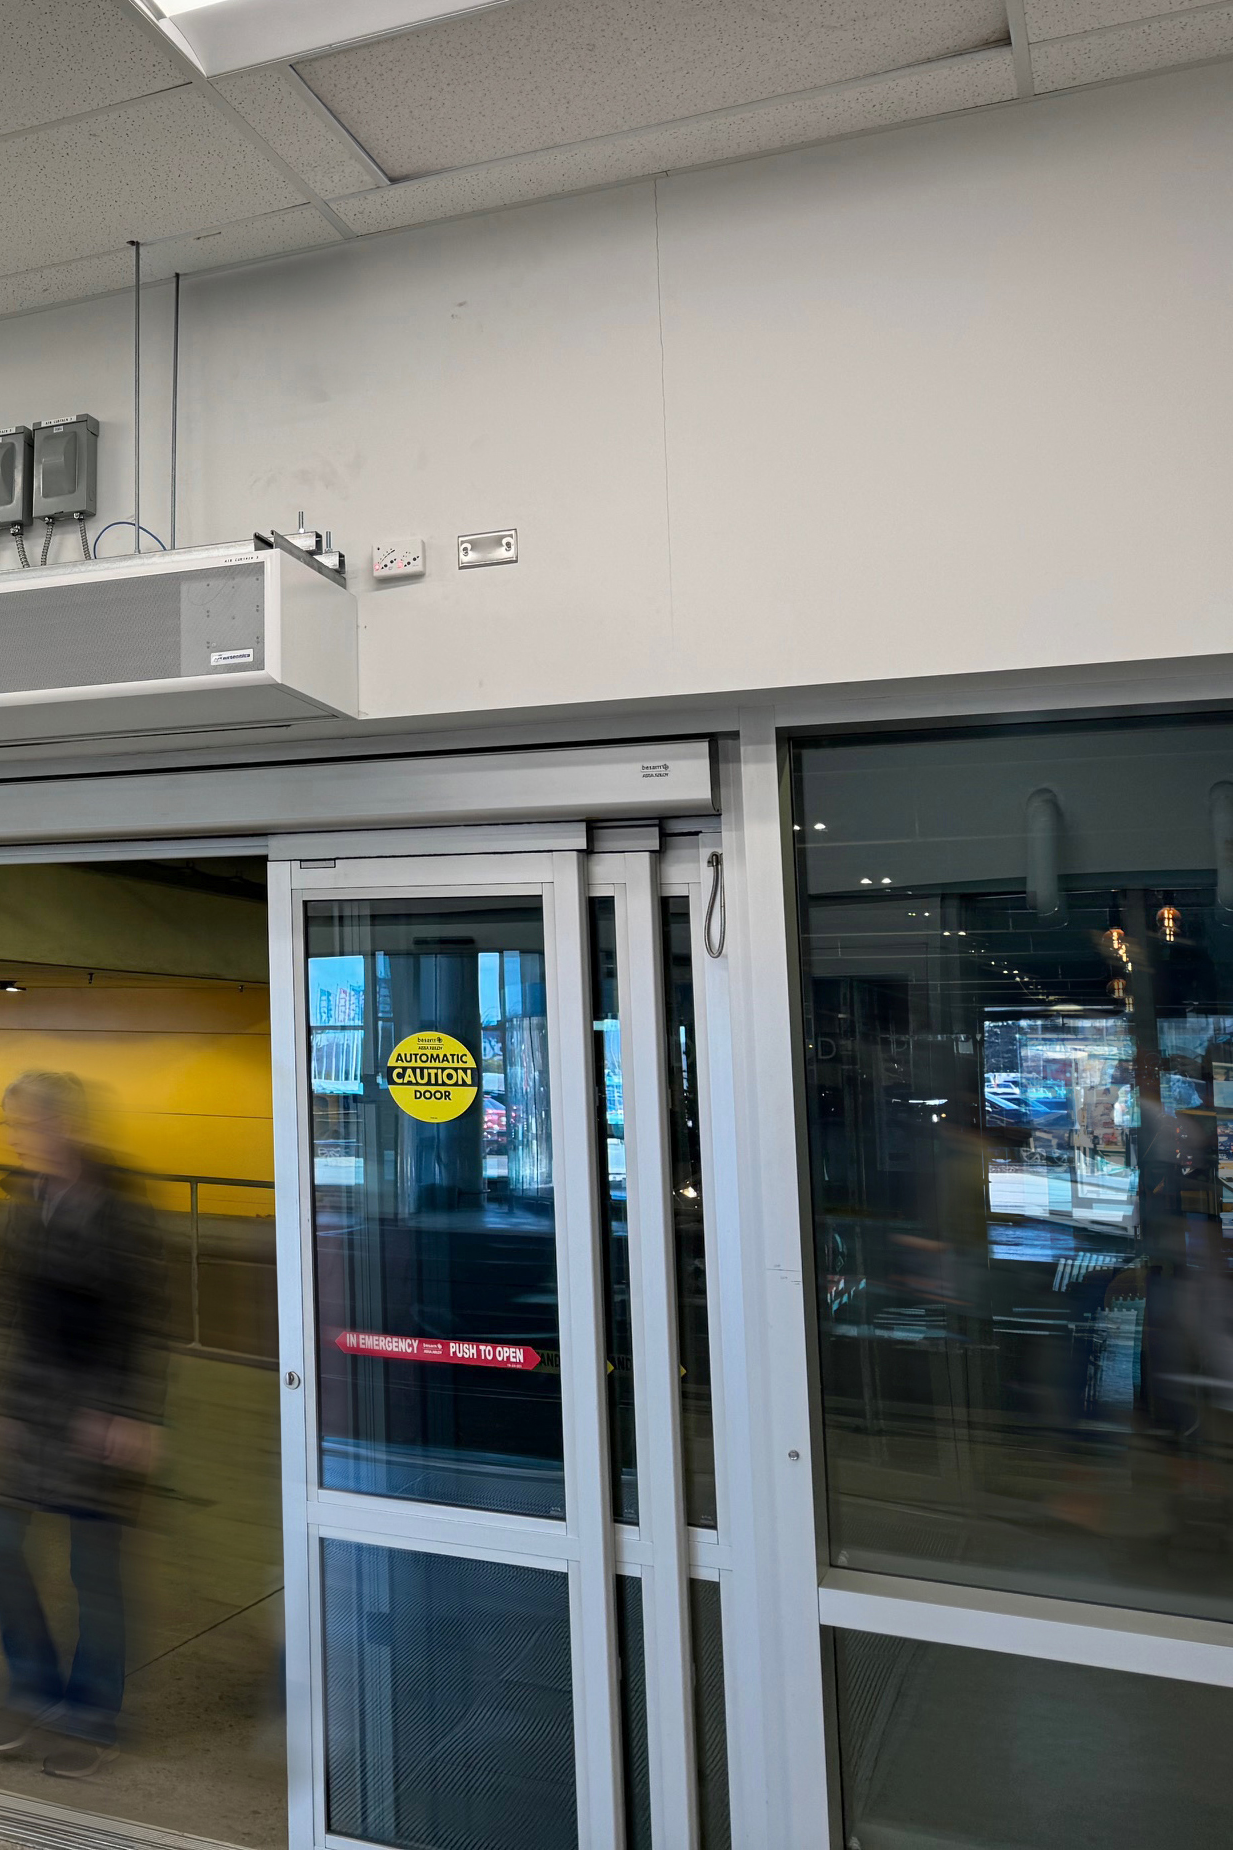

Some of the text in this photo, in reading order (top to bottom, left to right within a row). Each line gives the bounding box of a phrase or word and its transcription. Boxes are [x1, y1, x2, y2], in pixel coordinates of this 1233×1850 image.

[395, 1053, 468, 1064] AUTOMATIC
[392, 1068, 472, 1085] CAUTION
[414, 1089, 452, 1101] DOOR
[346, 1333, 524, 1362] IN EMERGENCY PUSH TO OPEN
